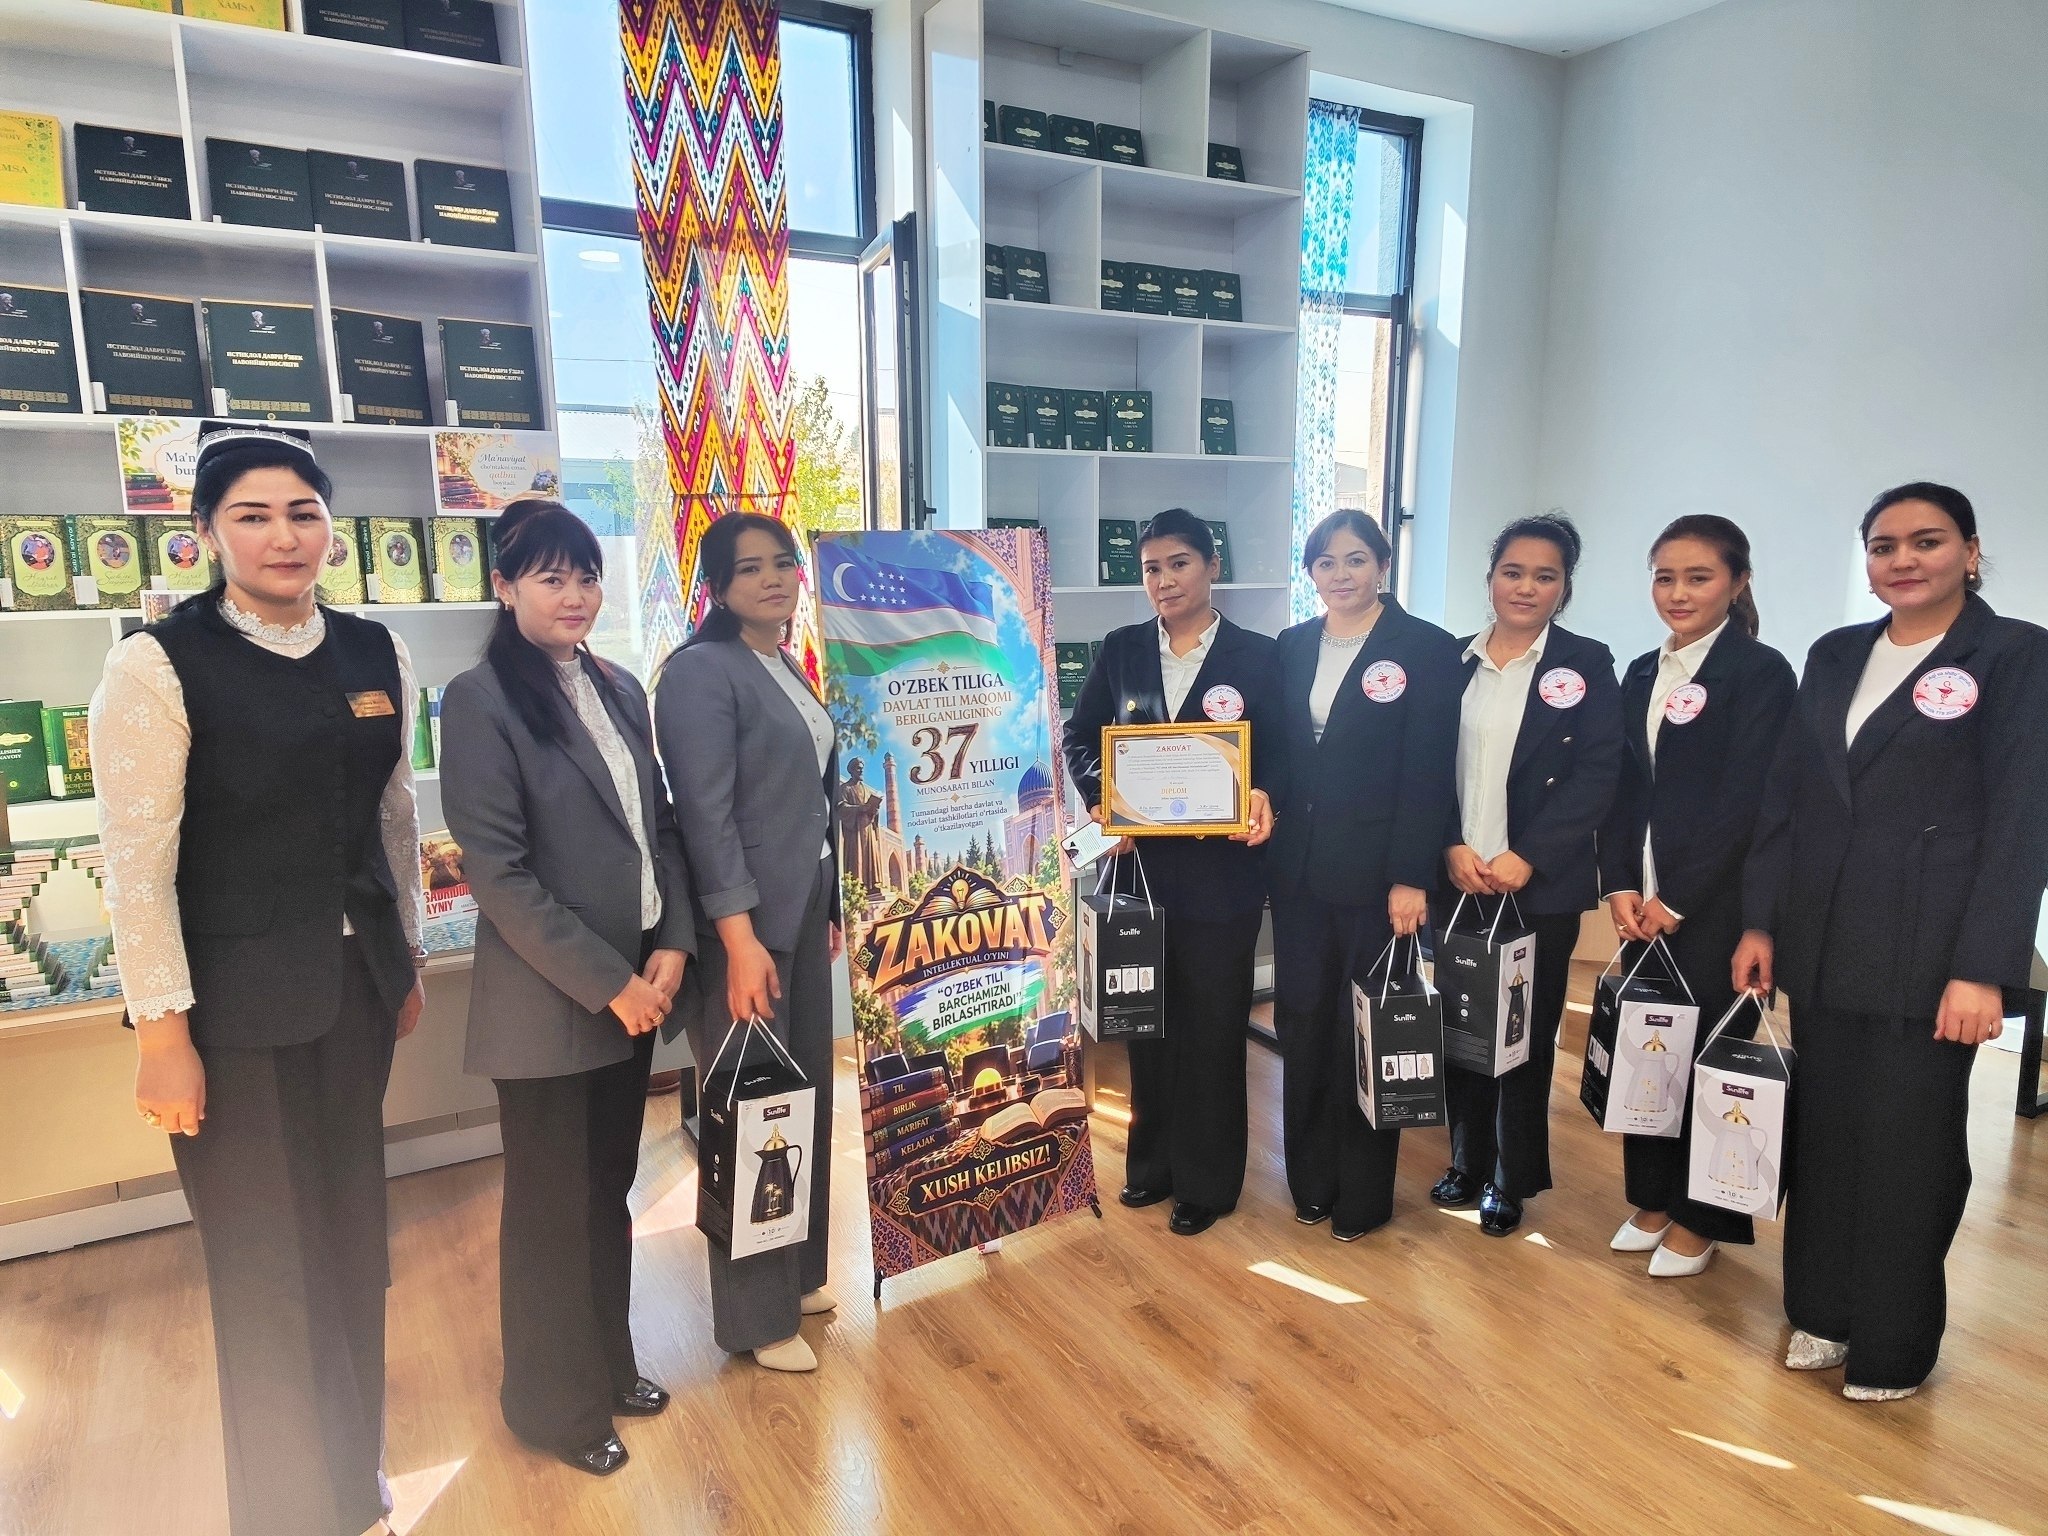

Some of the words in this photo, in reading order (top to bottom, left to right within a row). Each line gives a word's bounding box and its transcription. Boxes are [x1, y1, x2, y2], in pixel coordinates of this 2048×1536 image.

[952, 673, 1004, 691] TILIGA
[882, 697, 931, 714] DAVLAT
[932, 696, 956, 710] TILI
[959, 691, 1012, 709] MAQOMI
[895, 706, 1002, 726] BERILGANLIGINING
[909, 723, 980, 785] 37
[1156, 744, 1192, 753] ZAKOVAT
[969, 755, 1020, 774] YILLIGI
[64, 771, 92, 783] НАВ
[917, 782, 970, 796] MUNOSABATI
[972, 779, 995, 790] BILAN
[1161, 787, 1187, 795] DIPLOM
[911, 805, 949, 818] Tumandagi
[950, 802, 973, 812] barcha
[974, 800, 994, 809] davlat
[907, 816, 937, 828] nodavlat
[938, 811, 978, 823] tashkilotlari
[1119, 927, 1141, 937] Sunlife
[872, 894, 1051, 993] ZAKOVAT
[923, 955, 982, 977] INTELLEKTUAL
[1454, 956, 1478, 968] Sunlife
[985, 971, 1004, 984] TILI
[939, 983, 1011, 1014] BARCHAMIZNI
[1393, 1013, 1417, 1022] Sunlife
[892, 1084, 906, 1095] TIL
[766, 1106, 787, 1116] Sunlife
[892, 1100, 917, 1116] BIRLIK
[900, 1135, 936, 1156] KELAJAK
[920, 1171, 970, 1204] XUSH
[975, 1144, 1051, 1186] KELIBSIZ!
